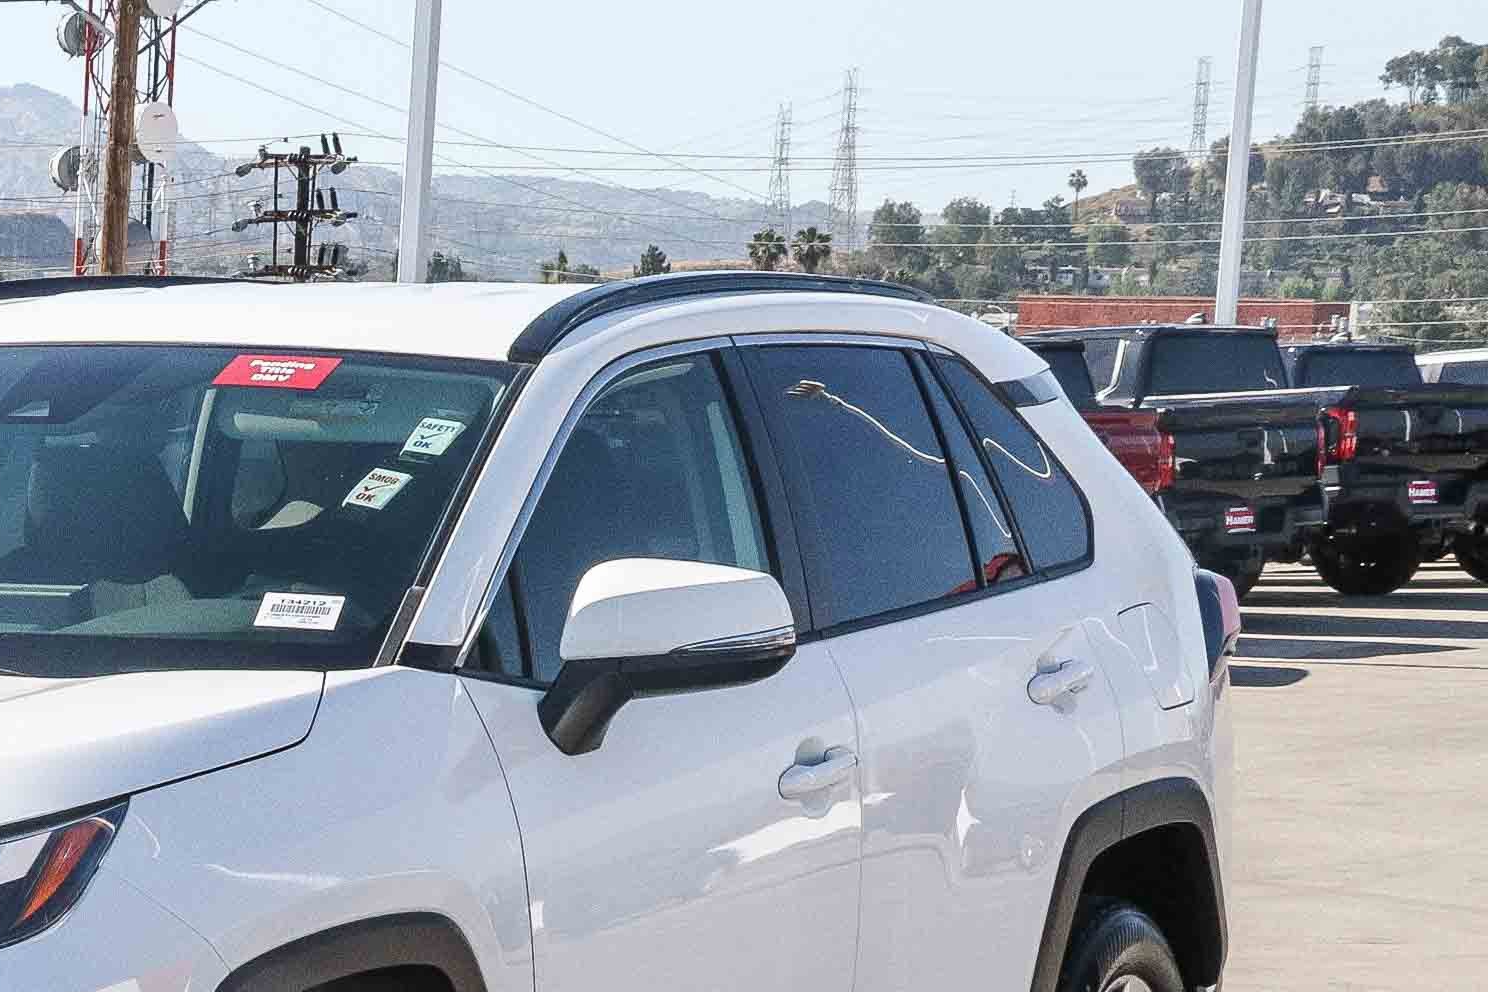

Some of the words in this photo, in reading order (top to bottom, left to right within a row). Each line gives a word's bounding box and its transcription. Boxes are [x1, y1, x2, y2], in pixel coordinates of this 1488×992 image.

[419, 421, 457, 433] SAFETY
[413, 440, 433, 449] OK
[368, 472, 401, 485] SMOG
[355, 492, 376, 502] OK
